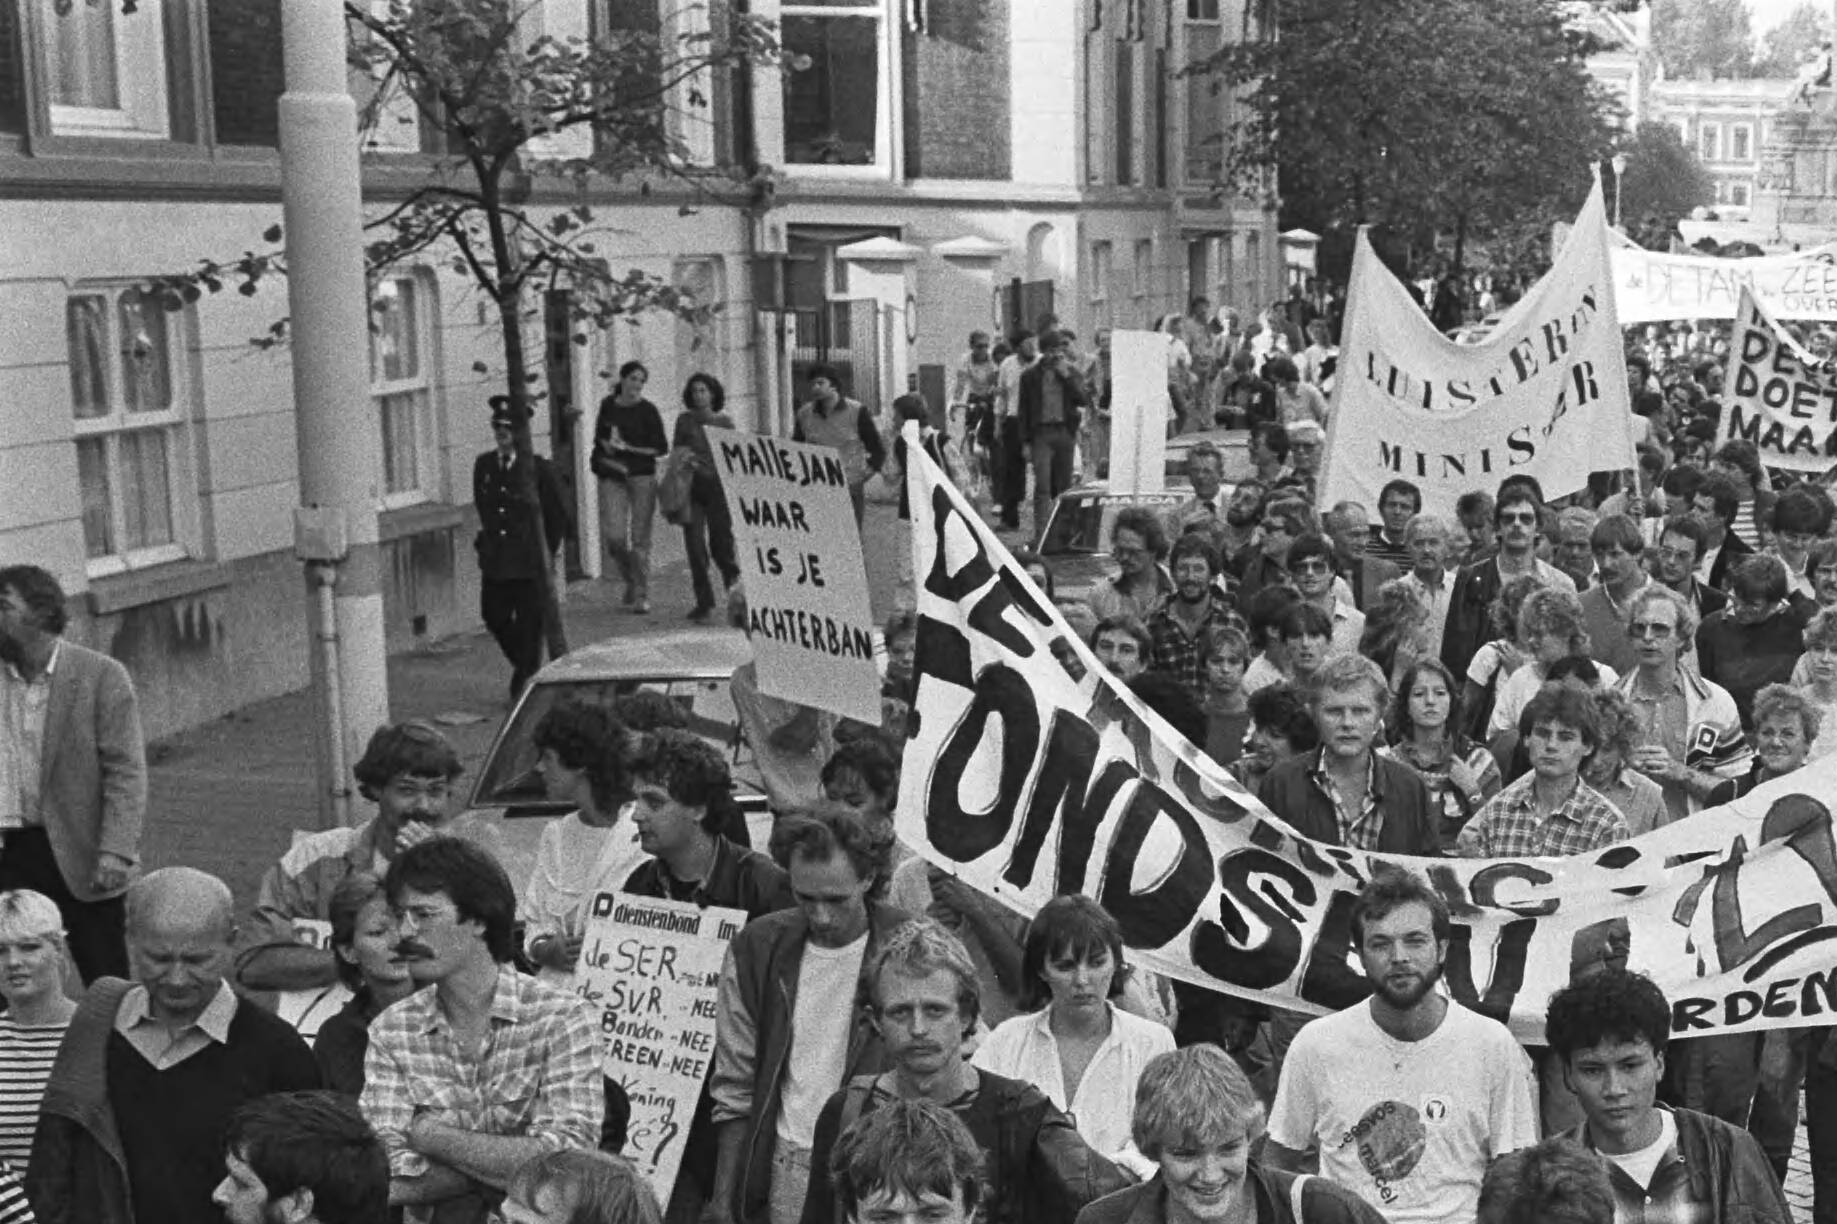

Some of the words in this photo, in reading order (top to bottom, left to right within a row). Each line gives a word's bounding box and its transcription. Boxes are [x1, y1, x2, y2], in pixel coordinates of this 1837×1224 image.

[1727, 405, 1819, 455] MAA
[799, 452, 845, 488] JAN
[739, 496, 810, 533] WAAR
[757, 547, 783, 576] IS
[797, 552, 826, 587] JE
[750, 606, 873, 660] ACHTERBAN
[613, 903, 701, 936] dienstenbond
[679, 1029, 713, 1053] NEE
[670, 1055, 705, 1080] NEE
